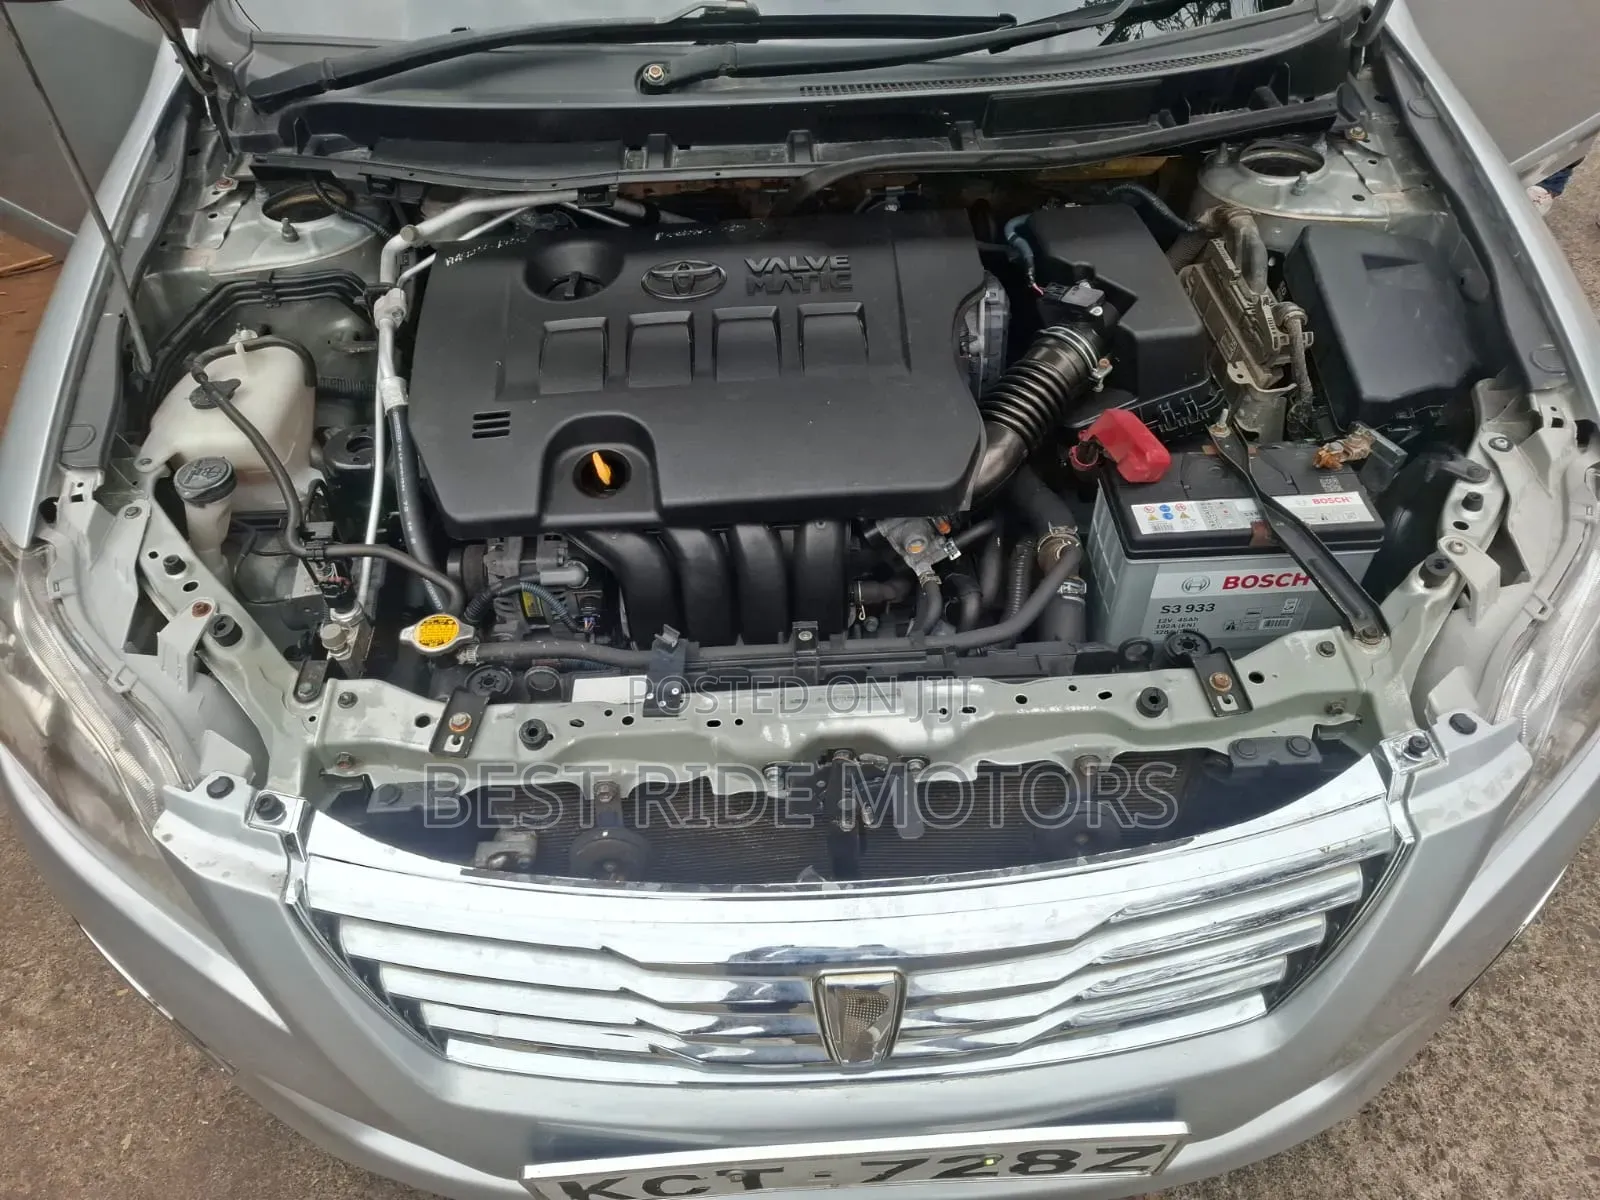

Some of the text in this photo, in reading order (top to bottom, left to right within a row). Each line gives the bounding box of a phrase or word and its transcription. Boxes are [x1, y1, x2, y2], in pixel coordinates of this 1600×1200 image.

[743, 255, 851, 274] VALVE
[745, 271, 853, 297] MATIC
[1311, 496, 1351, 505] BOSCH
[1222, 572, 1311, 590] BOSCH
[1160, 602, 1216, 614] S3 933
[557, 1144, 1167, 1200] KCT 728Z
